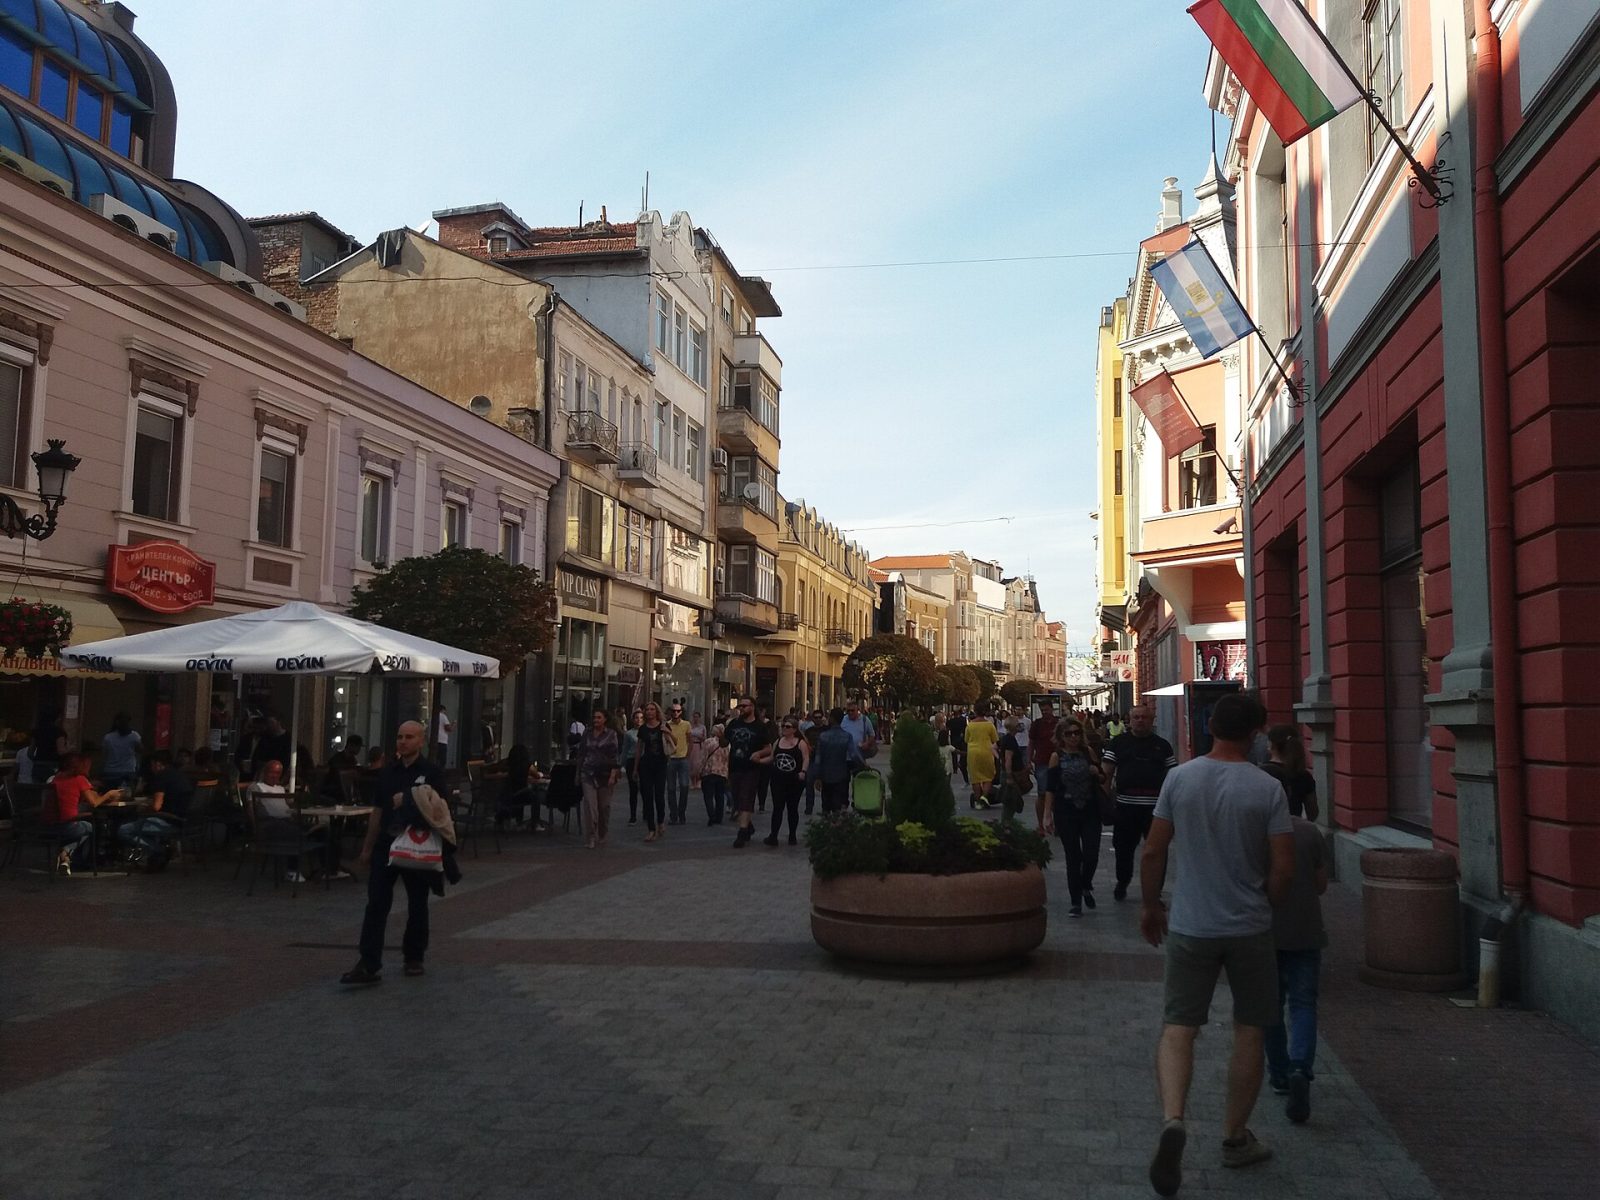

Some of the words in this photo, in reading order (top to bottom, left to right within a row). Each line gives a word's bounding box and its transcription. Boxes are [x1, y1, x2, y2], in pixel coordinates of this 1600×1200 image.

[141, 566, 191, 585] ЦЕНТЪР
[561, 571, 574, 593] VIP
[575, 575, 597, 599] CLASS
[186, 657, 233, 671] DEVIN
[276, 656, 325, 671] DEVIN
[383, 655, 410, 670] DEVIN
[442, 659, 460, 673] DEVIN
